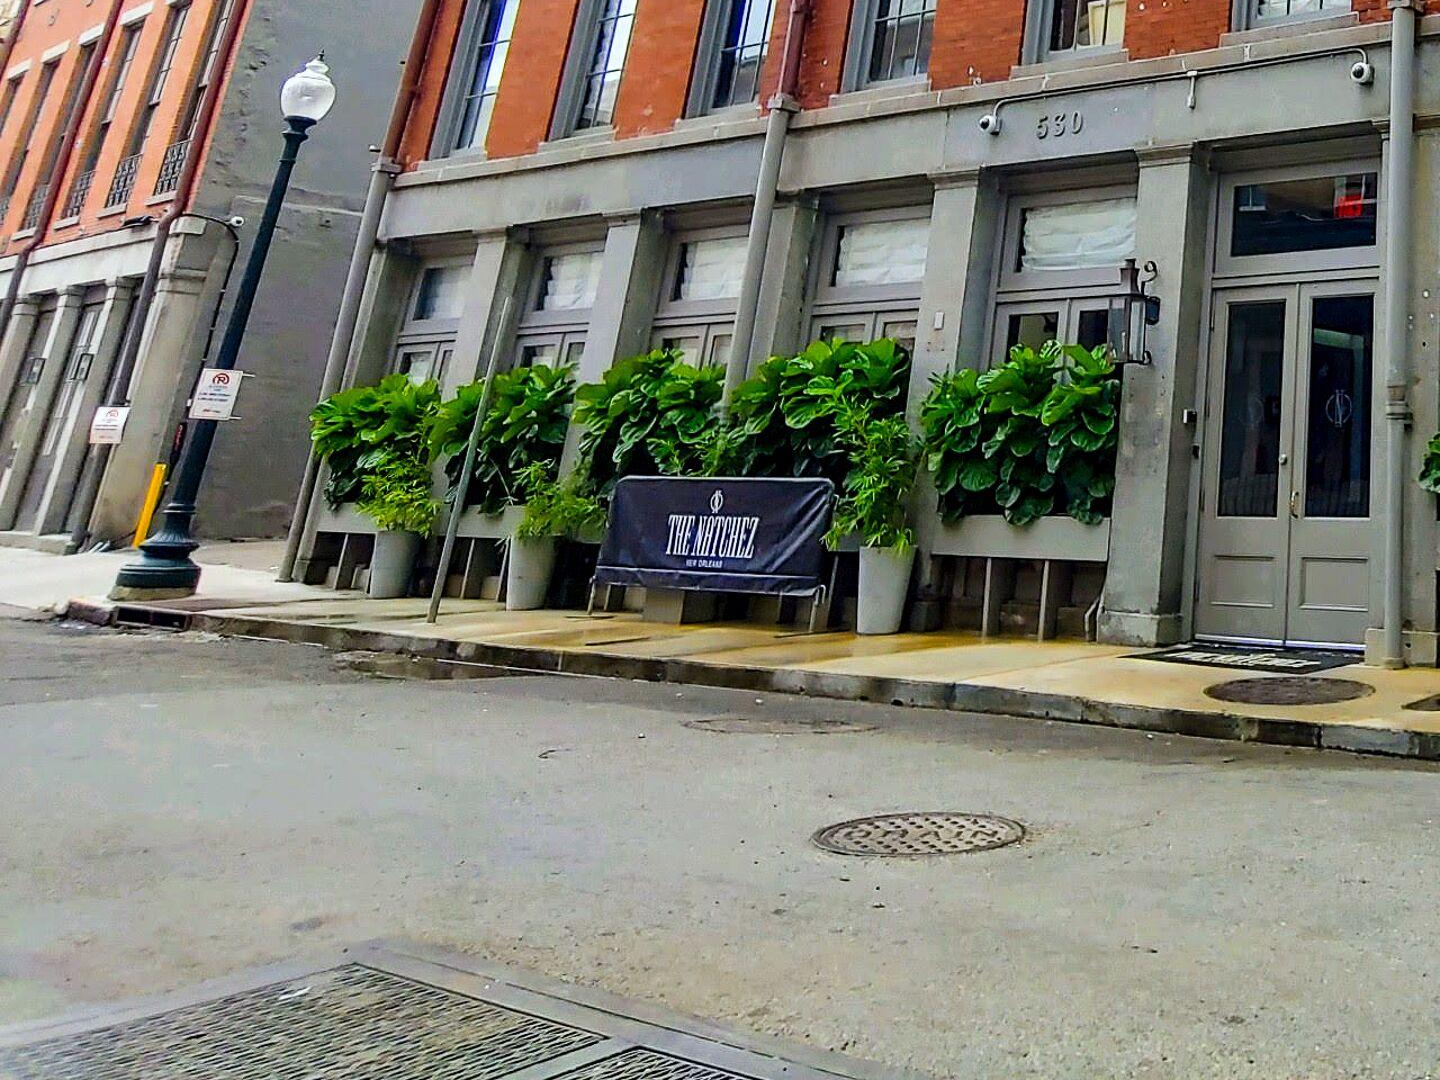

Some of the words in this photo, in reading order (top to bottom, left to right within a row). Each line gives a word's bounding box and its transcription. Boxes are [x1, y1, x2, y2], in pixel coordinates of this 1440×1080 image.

[1037, 111, 1084, 140] 530
[665, 514, 696, 556] THE
[690, 515, 760, 559] NATCHEZ
[685, 559, 698, 568] NEW
